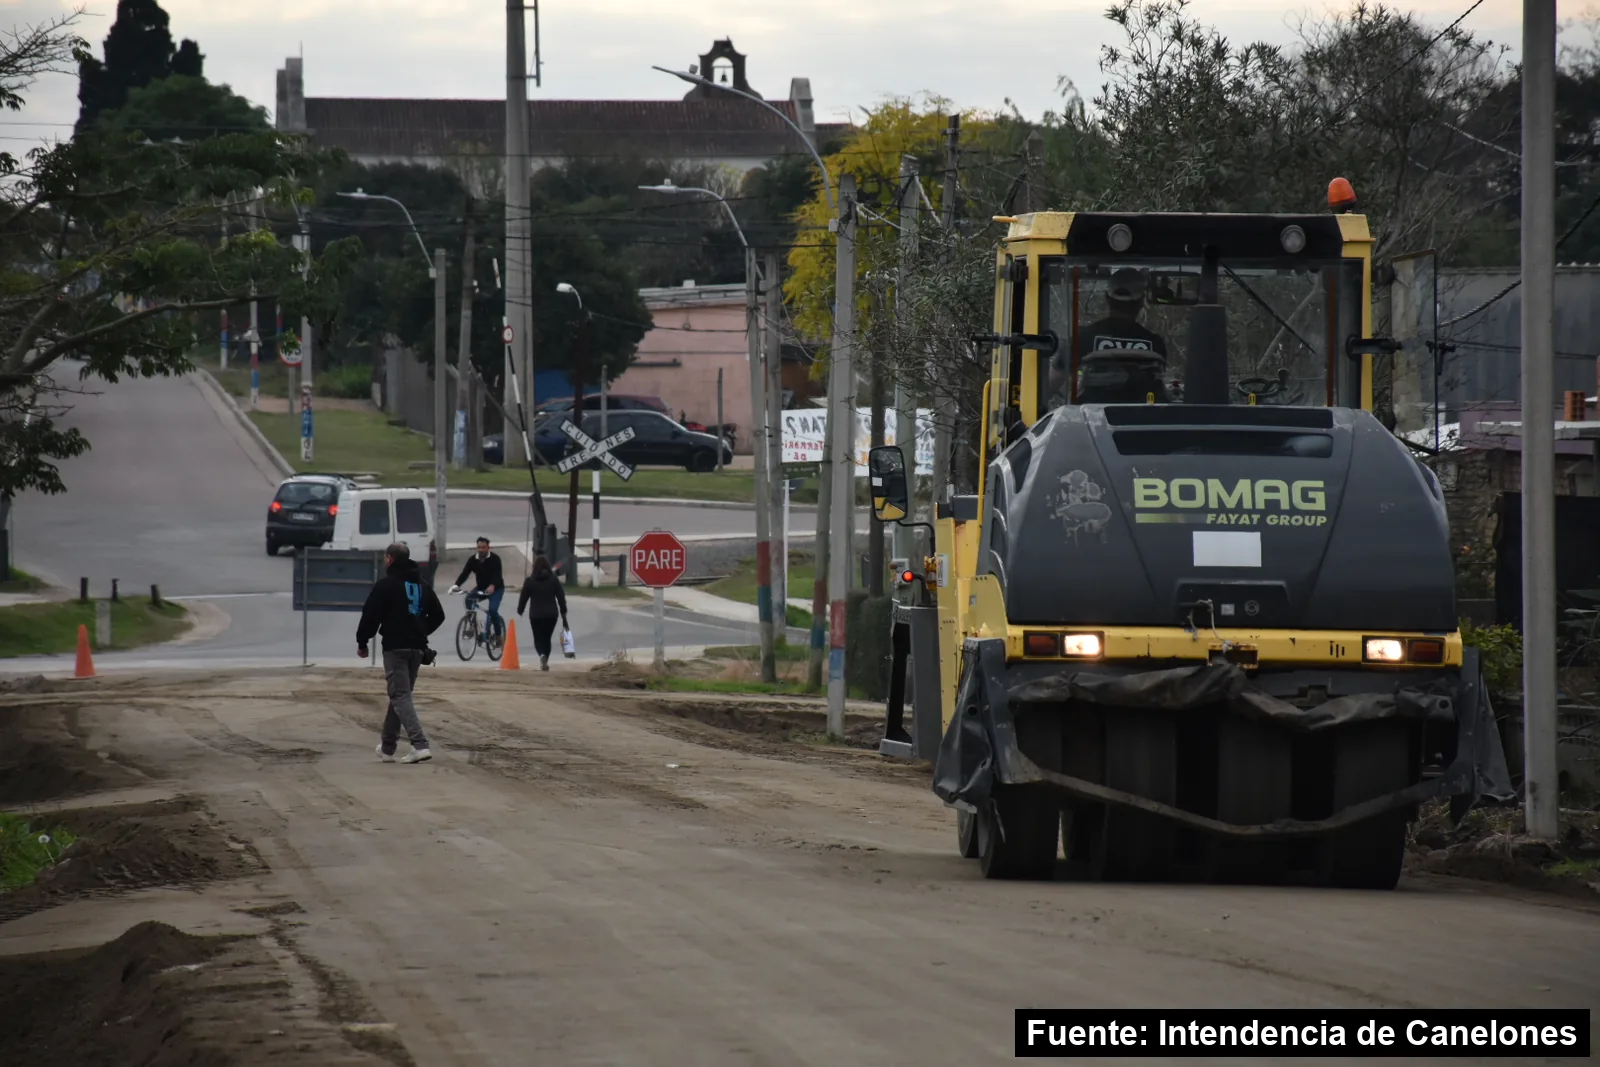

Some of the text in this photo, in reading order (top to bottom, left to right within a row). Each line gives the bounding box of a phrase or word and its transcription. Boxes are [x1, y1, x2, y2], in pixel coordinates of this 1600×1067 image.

[561, 428, 632, 470] TRENES
[564, 424, 627, 475] CUIDADO
[1133, 478, 1326, 511] BOMAG
[1206, 513, 1327, 527] FAYAT GROUP
[635, 549, 682, 570] PARE
